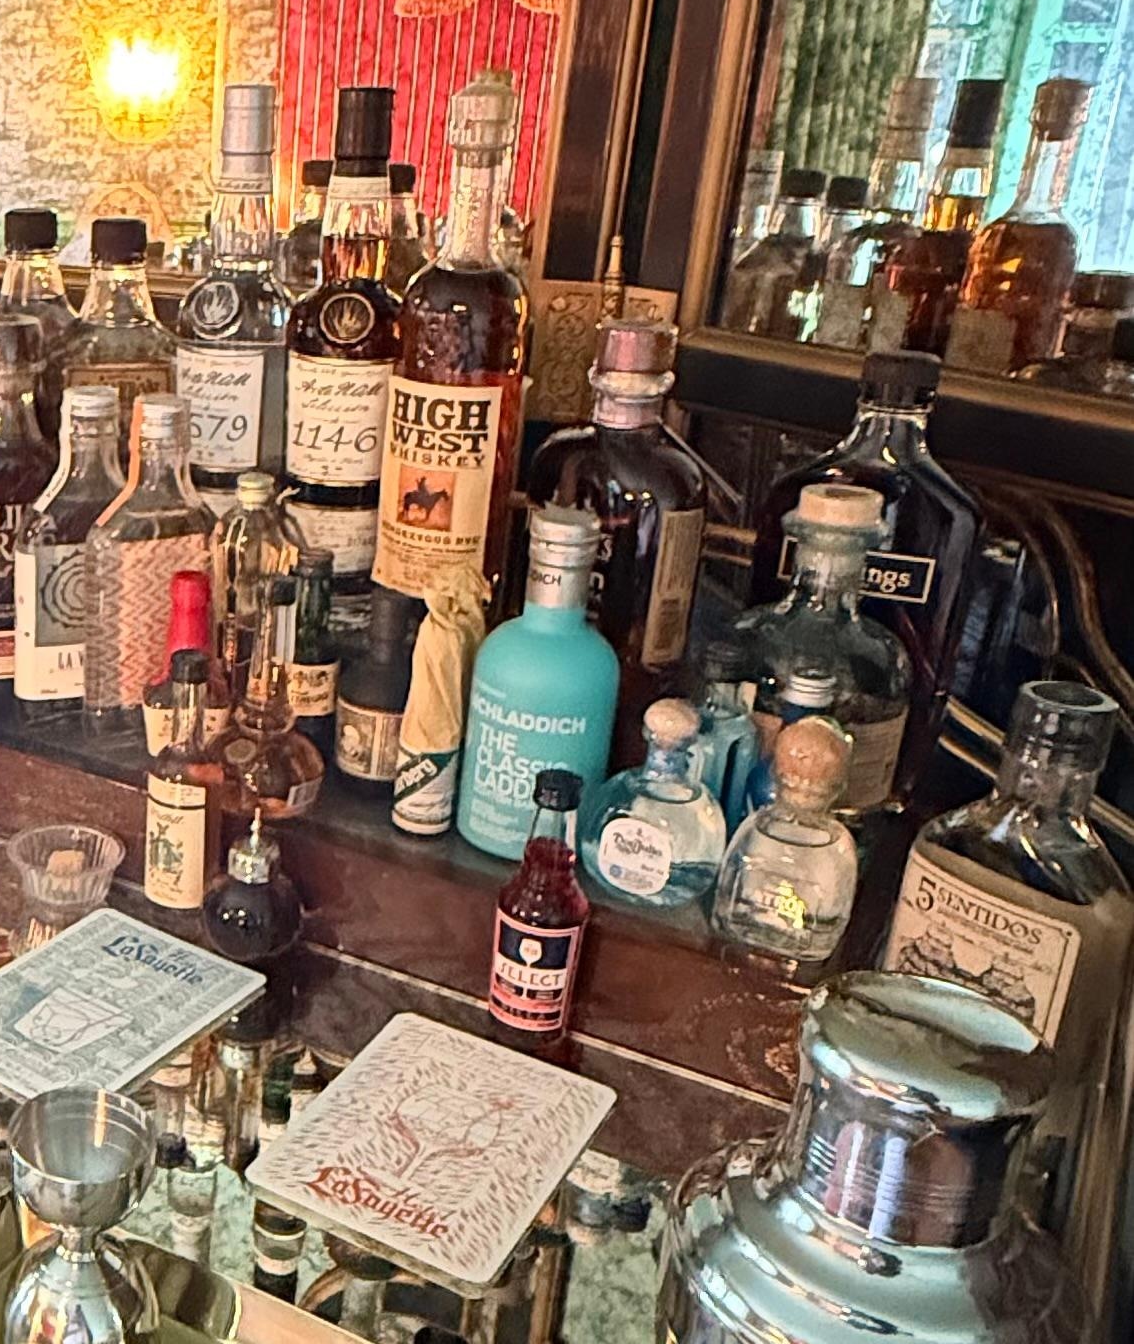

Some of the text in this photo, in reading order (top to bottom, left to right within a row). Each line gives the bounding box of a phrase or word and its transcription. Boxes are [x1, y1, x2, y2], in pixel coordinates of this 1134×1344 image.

[393, 388, 491, 432] HIGH
[291, 420, 379, 454] 1146
[391, 420, 489, 454] WEST
[389, 441, 486, 469] WHISKEY
[480, 722, 518, 757] THE
[916, 875, 937, 912] 5
[936, 887, 1044, 945] SENTIDOS
[499, 961, 563, 987] SELECT
